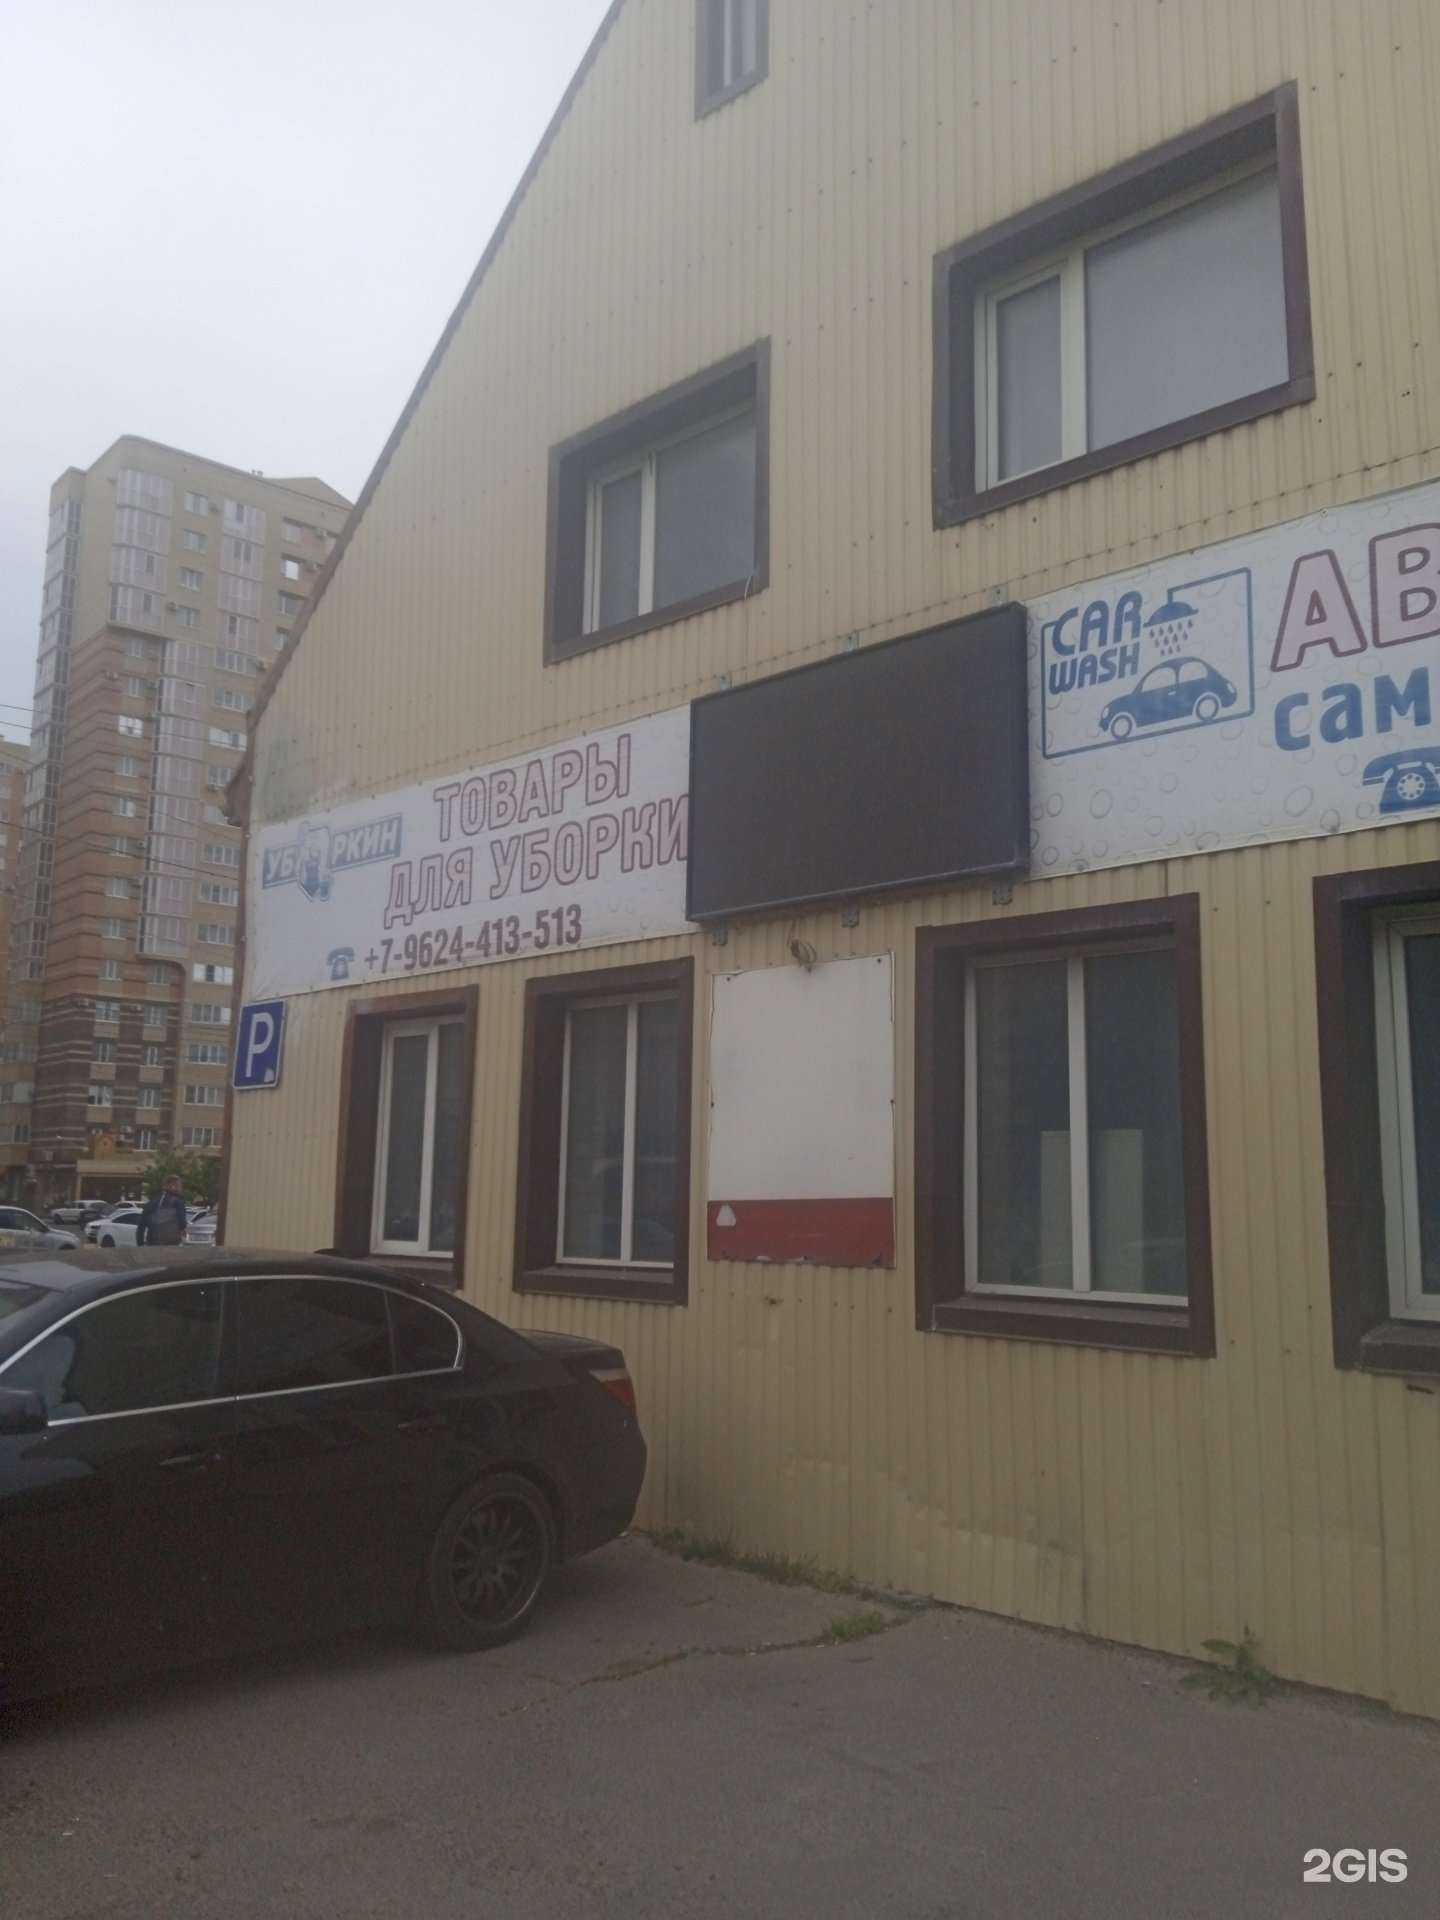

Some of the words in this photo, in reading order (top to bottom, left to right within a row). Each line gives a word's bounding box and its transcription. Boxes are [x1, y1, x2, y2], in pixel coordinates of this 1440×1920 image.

[1051, 590, 1143, 657] CAR
[1048, 642, 1141, 695] WASH
[1274, 666, 1431, 752] сам
[433, 733, 632, 842] ТОВАРЫ
[266, 819, 401, 882] УБРКИН
[383, 846, 474, 929] ДЛЯ
[489, 793, 689, 900] УБОРКИ
[364, 903, 583, 974] +7-9624-413-513
[245, 1011, 275, 1078] P
